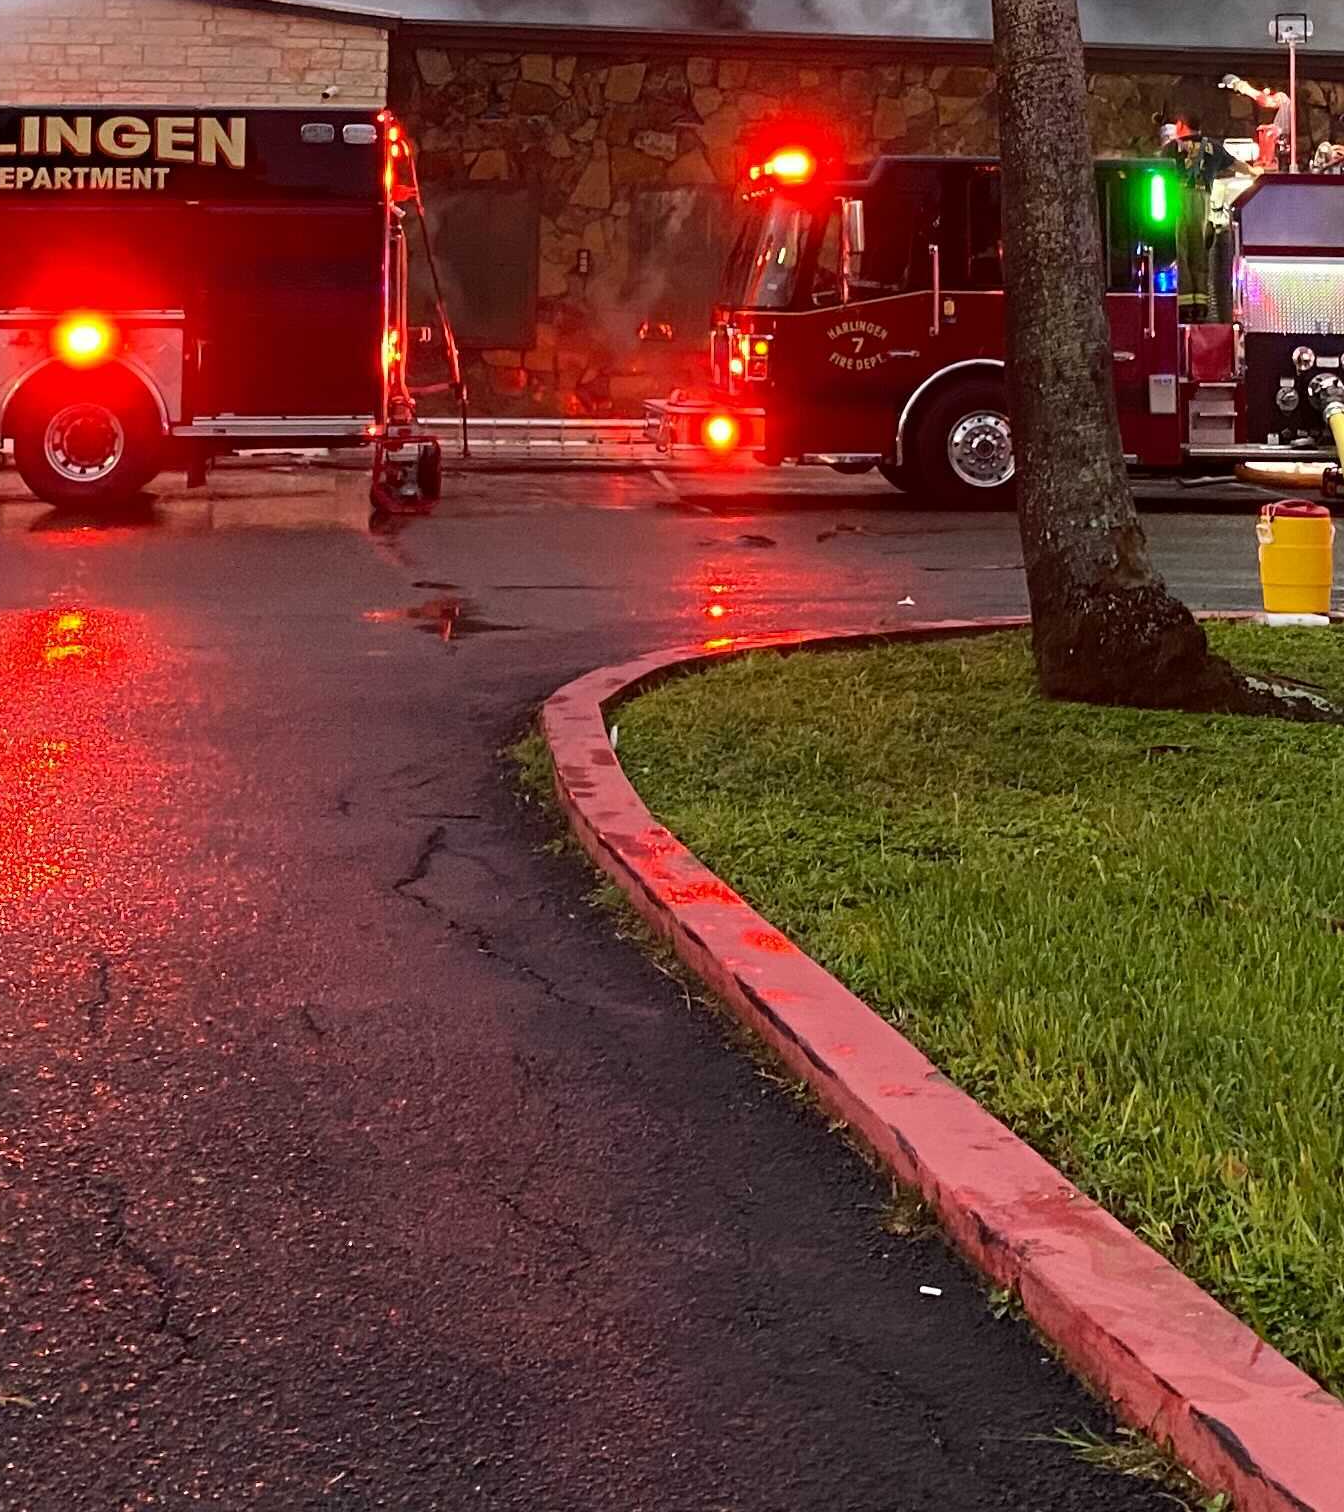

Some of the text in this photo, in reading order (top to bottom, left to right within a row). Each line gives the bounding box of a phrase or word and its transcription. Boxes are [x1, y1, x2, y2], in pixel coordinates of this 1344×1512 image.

[826, 320, 888, 341] HARLINGEN
[851, 337, 864, 353] 7
[829, 352, 854, 370] FIRE
